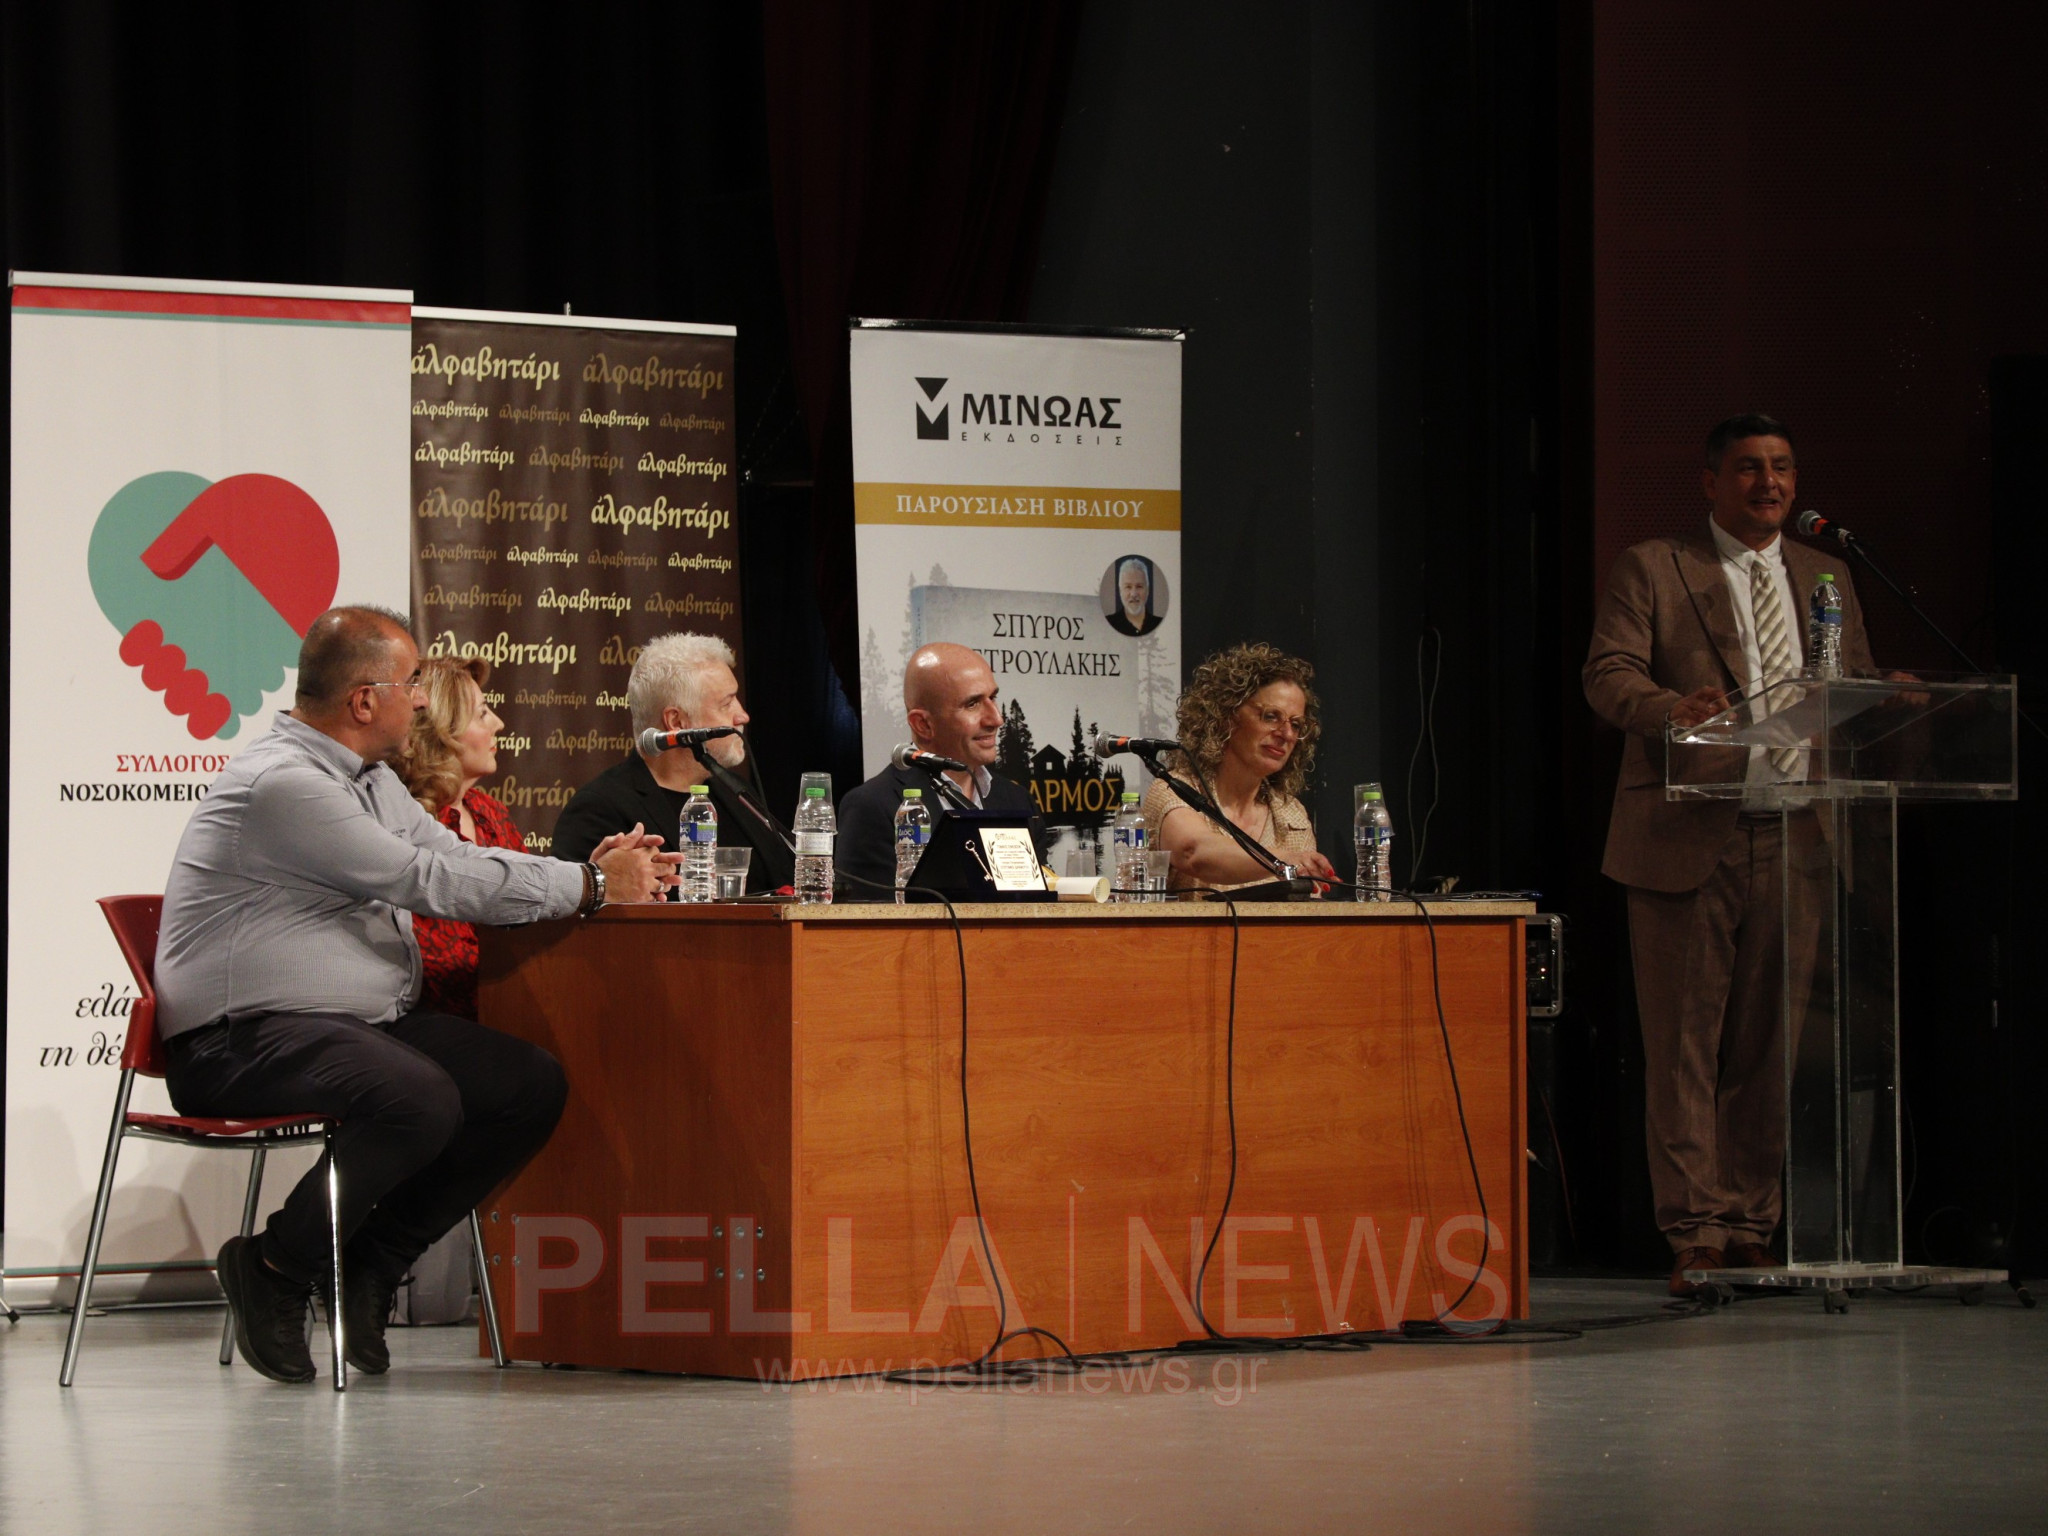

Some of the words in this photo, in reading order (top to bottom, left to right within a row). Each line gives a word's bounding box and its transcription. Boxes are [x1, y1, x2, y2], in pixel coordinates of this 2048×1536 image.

[961, 393, 1122, 429] ΜΙΝΩΑΣ
[961, 432, 1123, 446] ΕΚΔΟΣΕΙΣ
[896, 495, 1045, 516] ΠΑΡΟΥΣΙΑΣΗ
[1053, 499, 1144, 518] ΒΙΒΛΙΟΥ
[992, 613, 1085, 641] ΣΠΥΡΟΣ
[972, 649, 1121, 677] ΤΡΟΥΛΑΚΗΣ
[116, 755, 230, 772] ΣΥΛΛΟΓΟΣ
[60, 783, 213, 802] ΝΟΣΟΚΟΜΕΙΟ
[75, 982, 136, 1018] ελά
[87, 1031, 123, 1066] θέ
